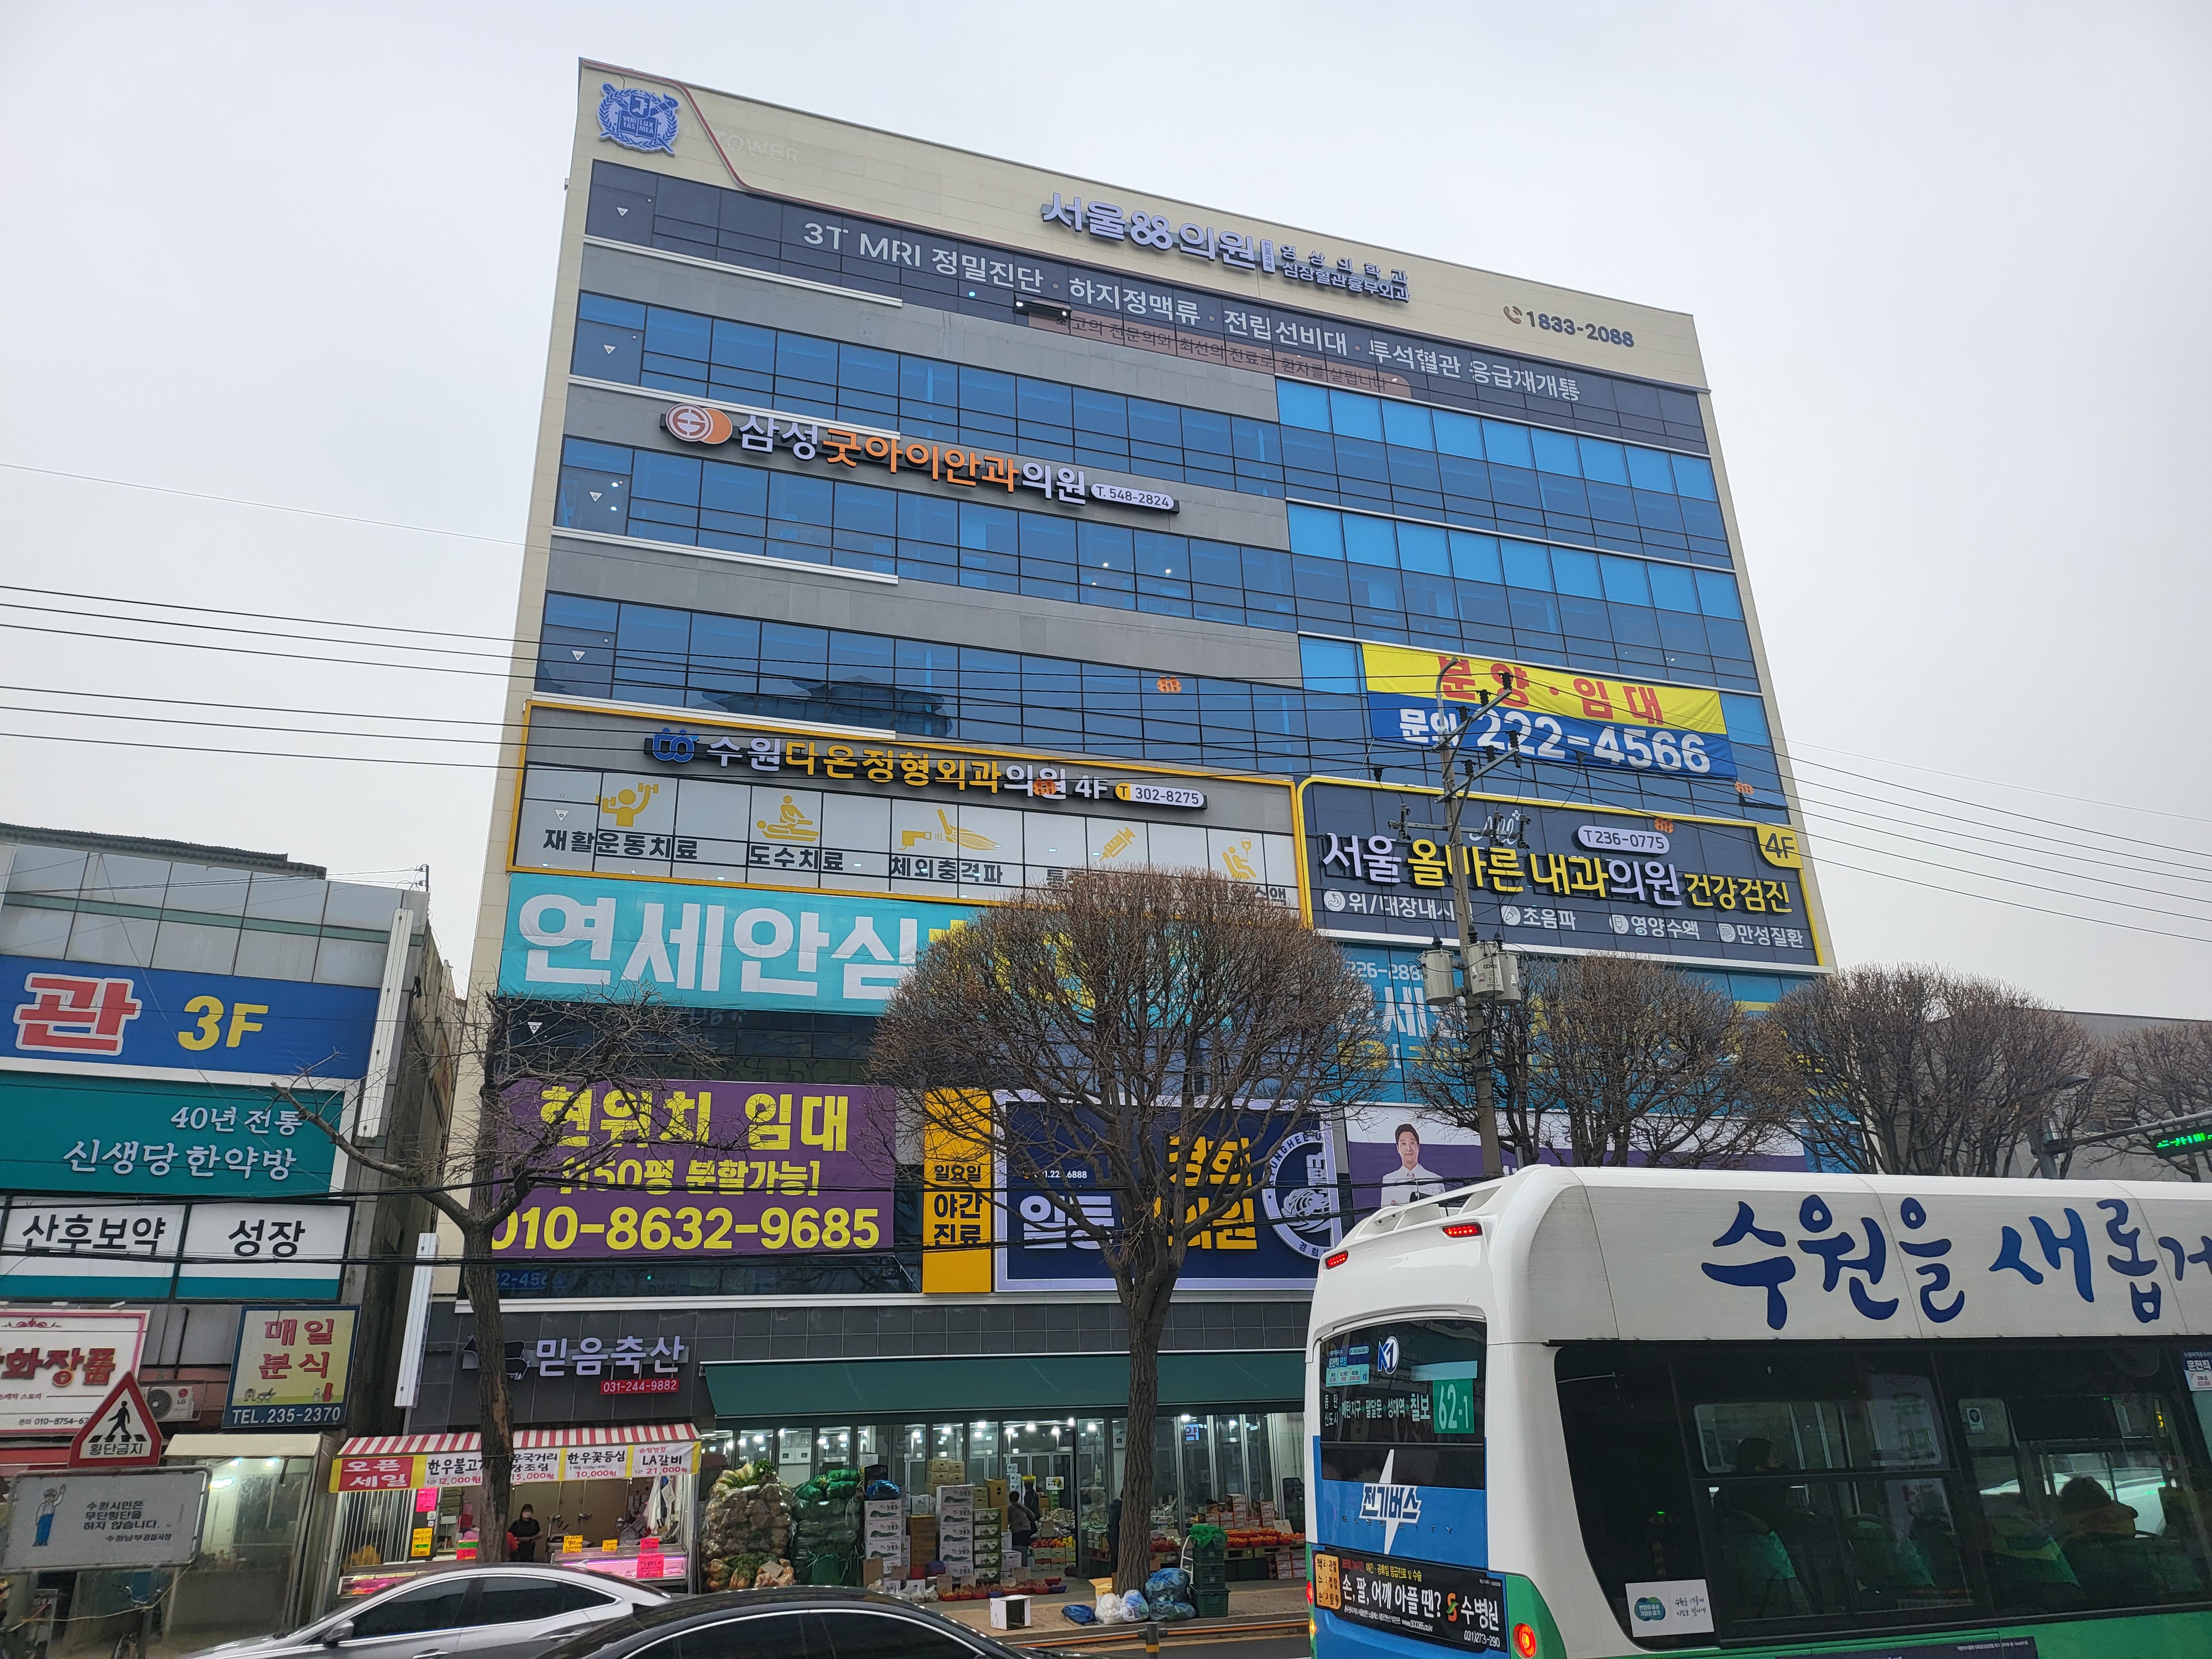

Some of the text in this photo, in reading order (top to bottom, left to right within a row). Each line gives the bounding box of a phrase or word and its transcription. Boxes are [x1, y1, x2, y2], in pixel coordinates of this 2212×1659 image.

[623, 115, 653, 128] VERI LUX
[639, 126, 654, 134] MEA
[1282, 262, 1410, 302] 심장혈관흉부외과
[804, 222, 1580, 402] 3T MRI 정밀진단 하지정맥류 전립선비대 투석혈관 응급재개통
[1526, 310, 1635, 348] 1833-2088
[1180, 337, 1225, 360] 최선의
[739, 415, 1087, 505] 삼성굿아이안과의원
[1109, 485, 1171, 508] 548-2824
[1439, 656, 1664, 726] 분양 임대
[1400, 708, 1712, 774] 문의 222-4566
[706, 735, 1067, 800] 수원다온정형외과의원
[1073, 775, 1107, 800] 4F
[1134, 786, 1199, 805] 302-8275
[543, 828, 698, 860] 재활운동치료
[749, 844, 844, 872] 도수치료
[1759, 831, 1796, 858] 4F
[891, 855, 1003, 883] 체외충격파
[1323, 833, 1402, 884] 서울
[1530, 854, 1682, 906] 내과의원
[1684, 873, 1793, 914] 건강검진
[1348, 893, 1472, 921] 위/대장내시
[1522, 907, 1576, 931] 초음파
[1630, 916, 1700, 941] 영양수액
[1736, 923, 1804, 949] 만성질환
[1346, 961, 1425, 982] 226-288
[14, 973, 269, 1056] 관 3F
[170, 1106, 304, 1137] 40년 전통
[540, 1085, 849, 1151] 현위치 임대
[63, 1139, 297, 1181] 신생당 한약방
[933, 1164, 982, 1182] 일요일
[1034, 1170, 1087, 1178] 1.22.6888
[933, 1192, 983, 1219] 야간
[22, 1214, 166, 1255] 산후보약
[228, 1219, 306, 1258] 성장
[491, 1206, 880, 1250] 010-8632-9685
[933, 1224, 982, 1245] 진료
[1700, 1193, 1965, 1331] 수원을
[264, 1318, 335, 1347] 매일
[0, 1347, 116, 1387] 화장품
[259, 1351, 330, 1380] 분식
[535, 1335, 685, 1378] 믿음축산
[603, 1379, 678, 1394] 031-244-9882
[34, 1416, 90, 1426] 010-8754-62
[1365, 1399, 1383, 1419] 팔달문
[1387, 1397, 1405, 1419] 성대역
[1411, 1393, 1431, 1422] 칠보
[88, 1442, 143, 1457] 횡단금지
[567, 1450, 625, 1464] 한우꽃등심
[642, 1454, 682, 1467] LA갈비
[343, 1459, 401, 1474] 오픈
[439, 1475, 482, 1485] 12,000원
[576, 1470, 617, 1479] 10,000원
[646, 1467, 688, 1475] 21,000원
[348, 1474, 410, 1489] 세일
[85, 1510, 142, 1521] 무단횡단을
[86, 1500, 144, 1511] 수원시민은
[1361, 1486, 1420, 1520] 전기버스
[83, 1521, 106, 1531] 하지
[1371, 1579, 1392, 1610] 어깨
[1395, 1584, 1419, 1616] 아플
[1421, 1589, 1441, 1618] 땐?
[1460, 1595, 1499, 1631] 수병원
